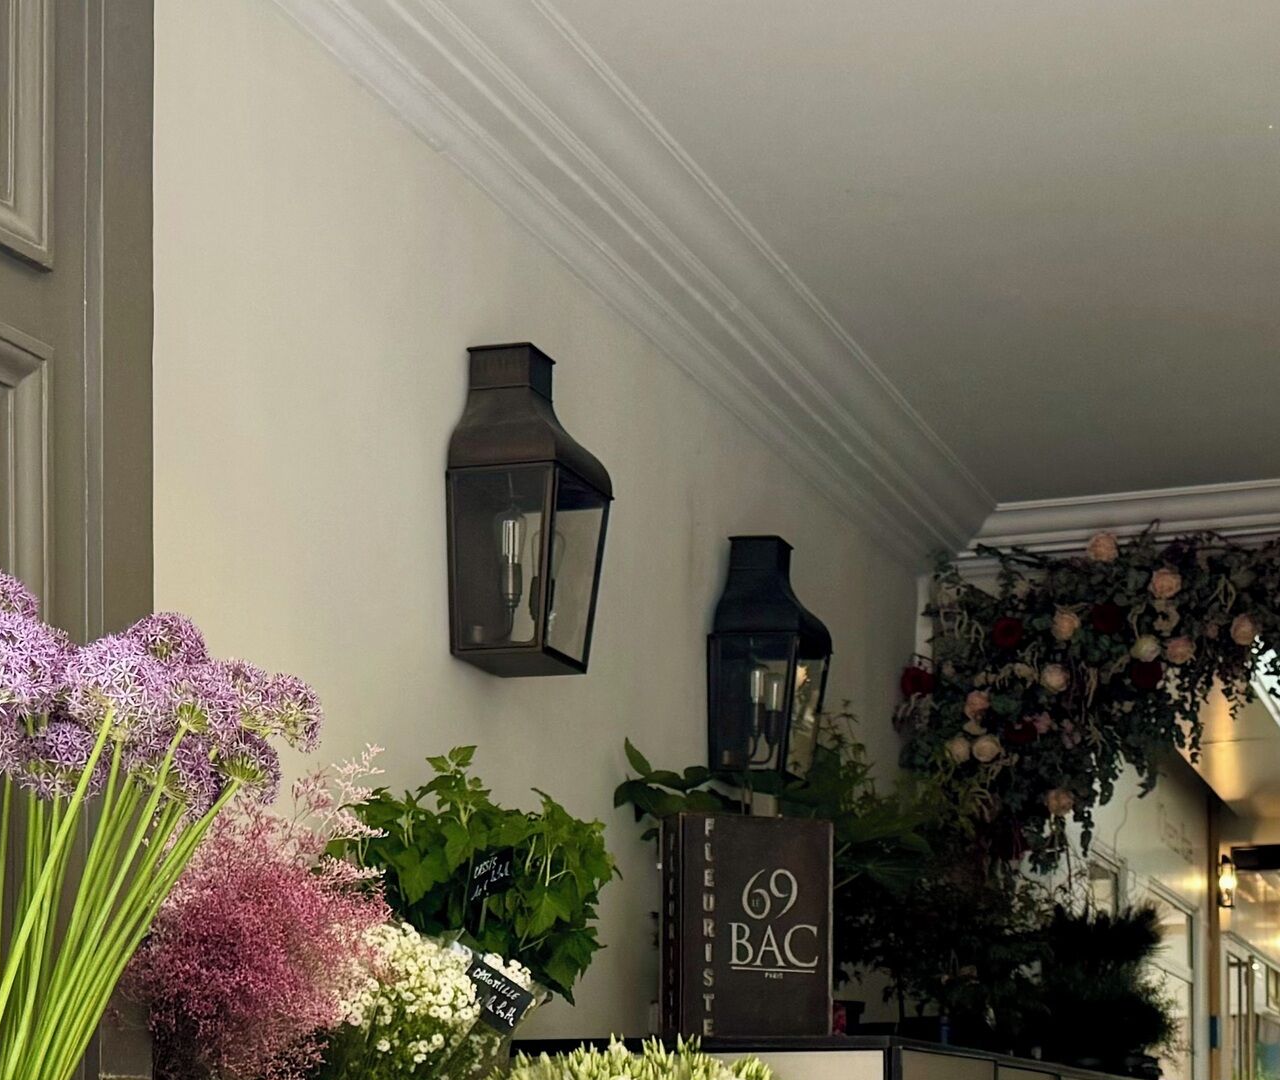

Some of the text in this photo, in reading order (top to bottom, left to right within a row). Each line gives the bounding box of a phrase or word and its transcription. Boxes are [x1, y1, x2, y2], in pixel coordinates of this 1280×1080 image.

[741, 868, 798, 920] 69
[702, 818, 716, 1037] FLEURISTE
[728, 922, 819, 968] BAC
